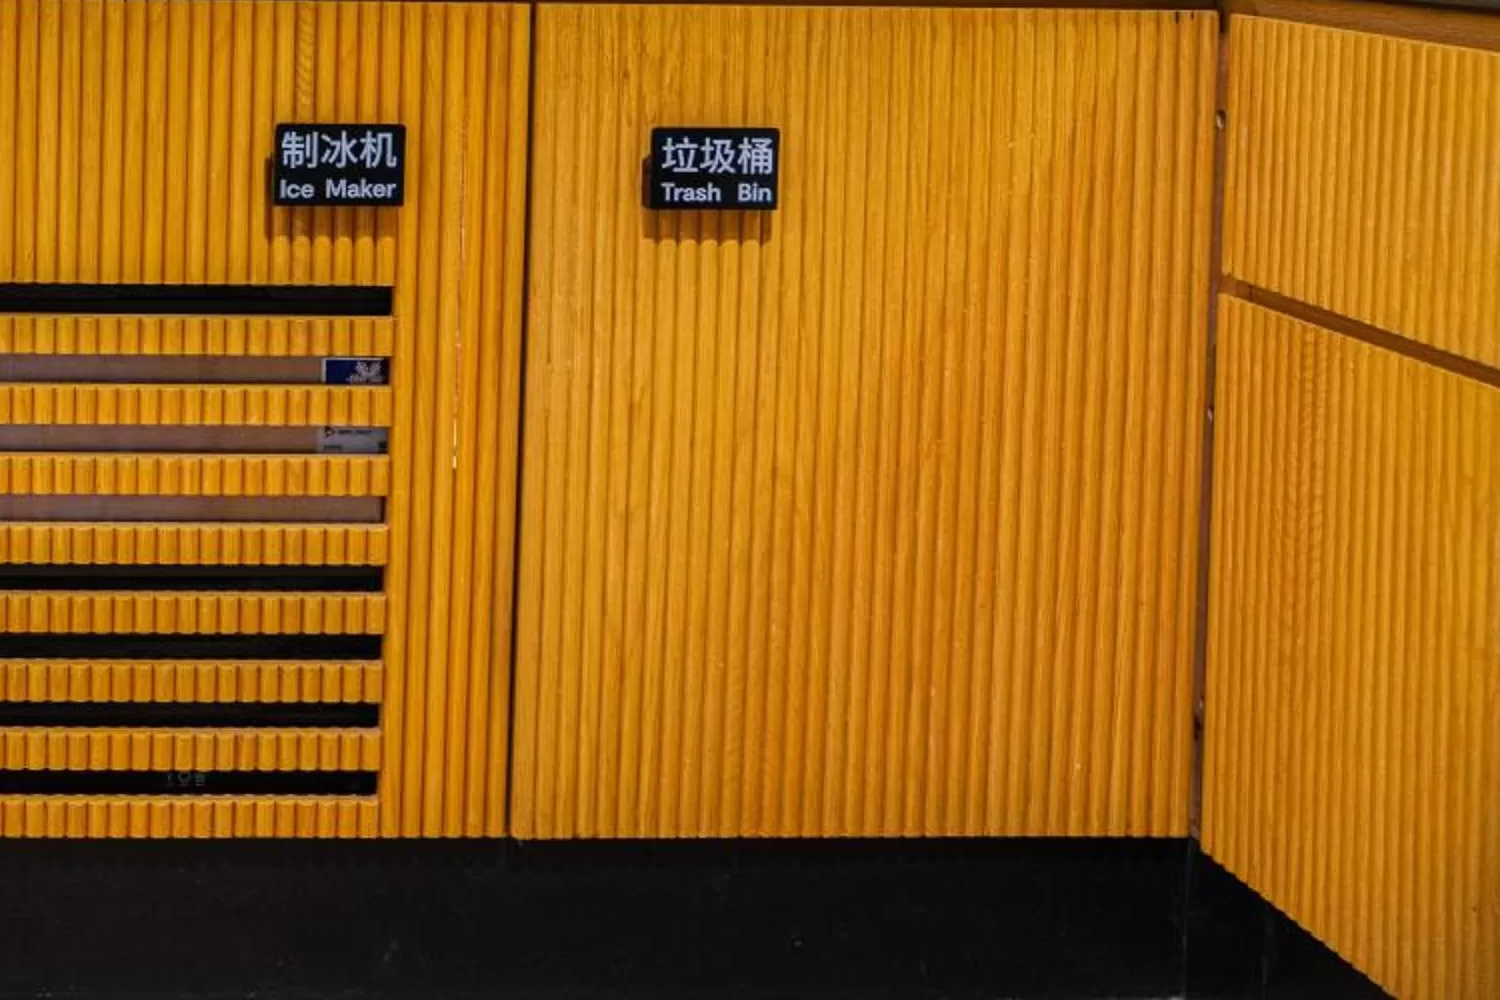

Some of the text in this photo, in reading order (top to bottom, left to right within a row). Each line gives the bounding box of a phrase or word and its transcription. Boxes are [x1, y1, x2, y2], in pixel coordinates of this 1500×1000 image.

[281, 130, 397, 168] 制冰机
[661, 137, 773, 174] 垃圾桶
[280, 178, 396, 198] Ice Maker
[661, 182, 772, 202] Trash Bin
